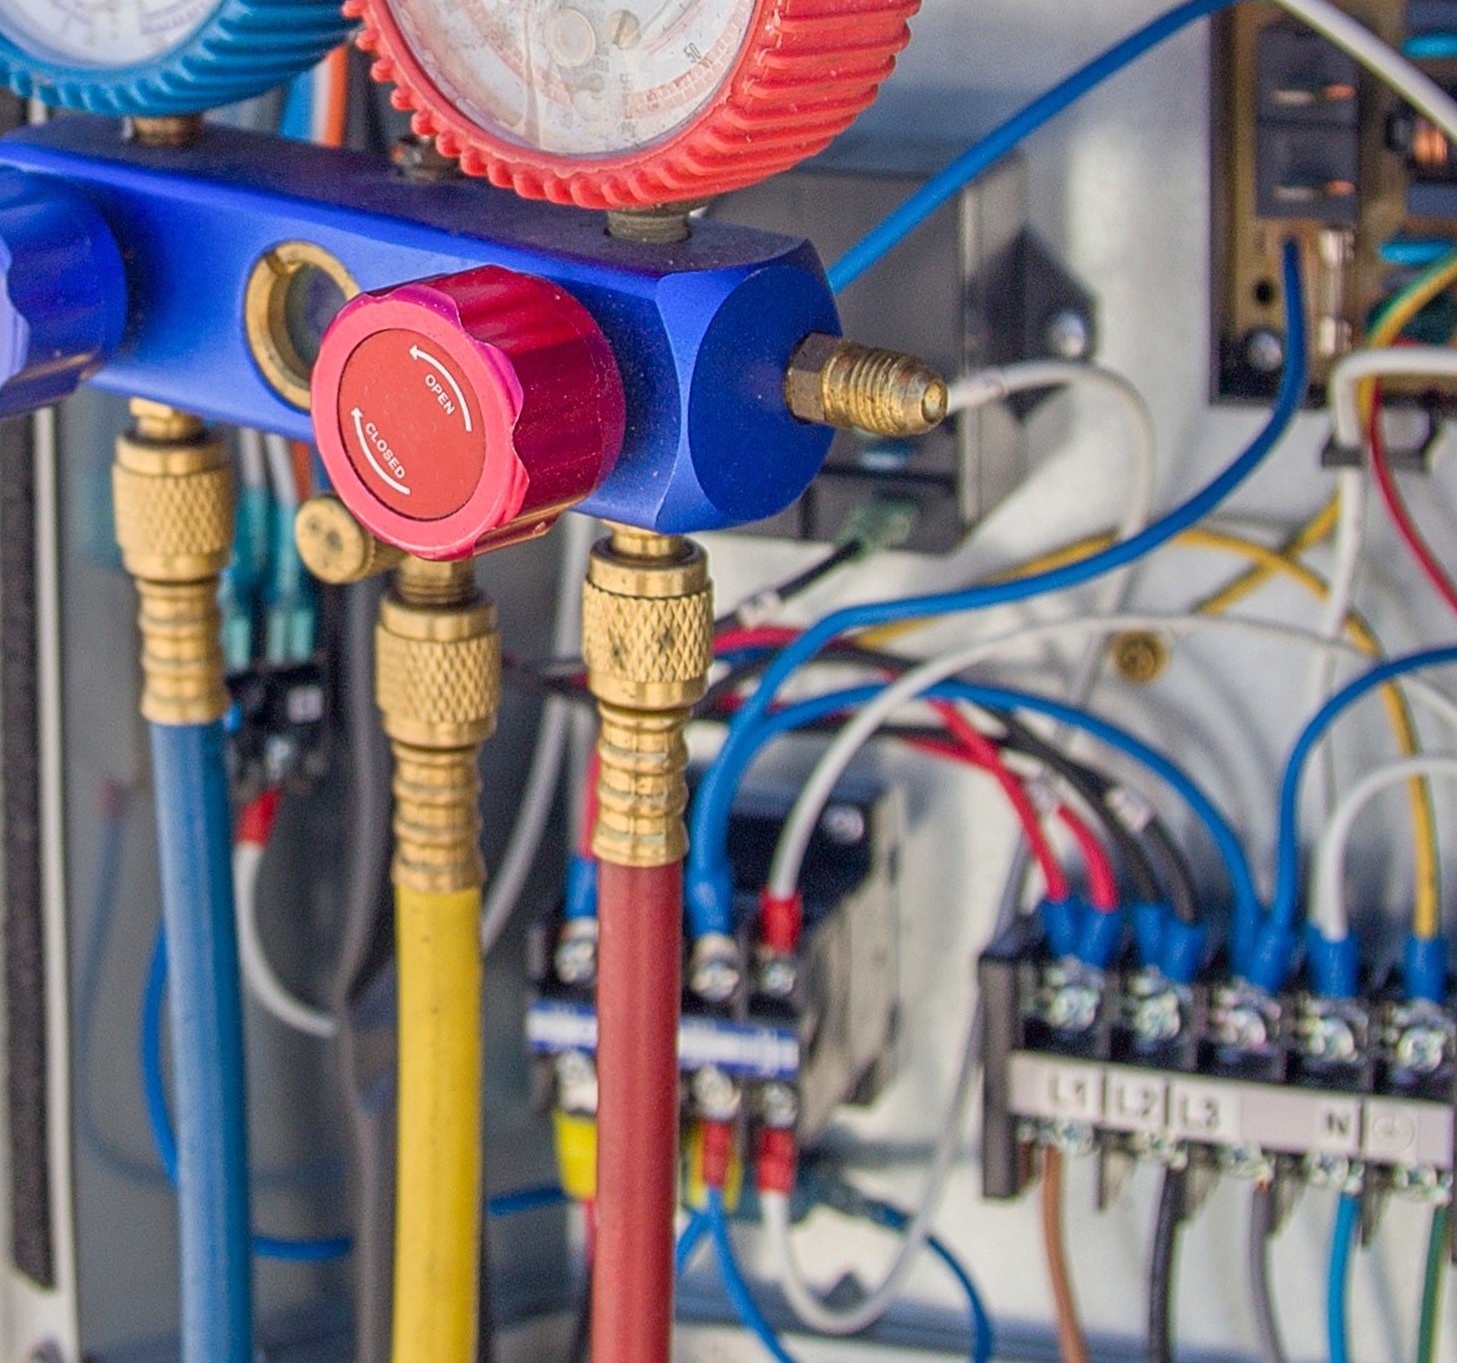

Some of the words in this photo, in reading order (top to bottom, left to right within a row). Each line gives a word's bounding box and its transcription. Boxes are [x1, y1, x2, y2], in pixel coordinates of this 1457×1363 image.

[682, 42, 703, 64] 50
[424, 373, 456, 416] OPEN
[364, 421, 406, 480] CLOSED
[1049, 1069, 1087, 1109] L1
[1117, 1082, 1155, 1118] L2
[1180, 1093, 1221, 1129] L3
[1323, 1109, 1350, 1136] N
